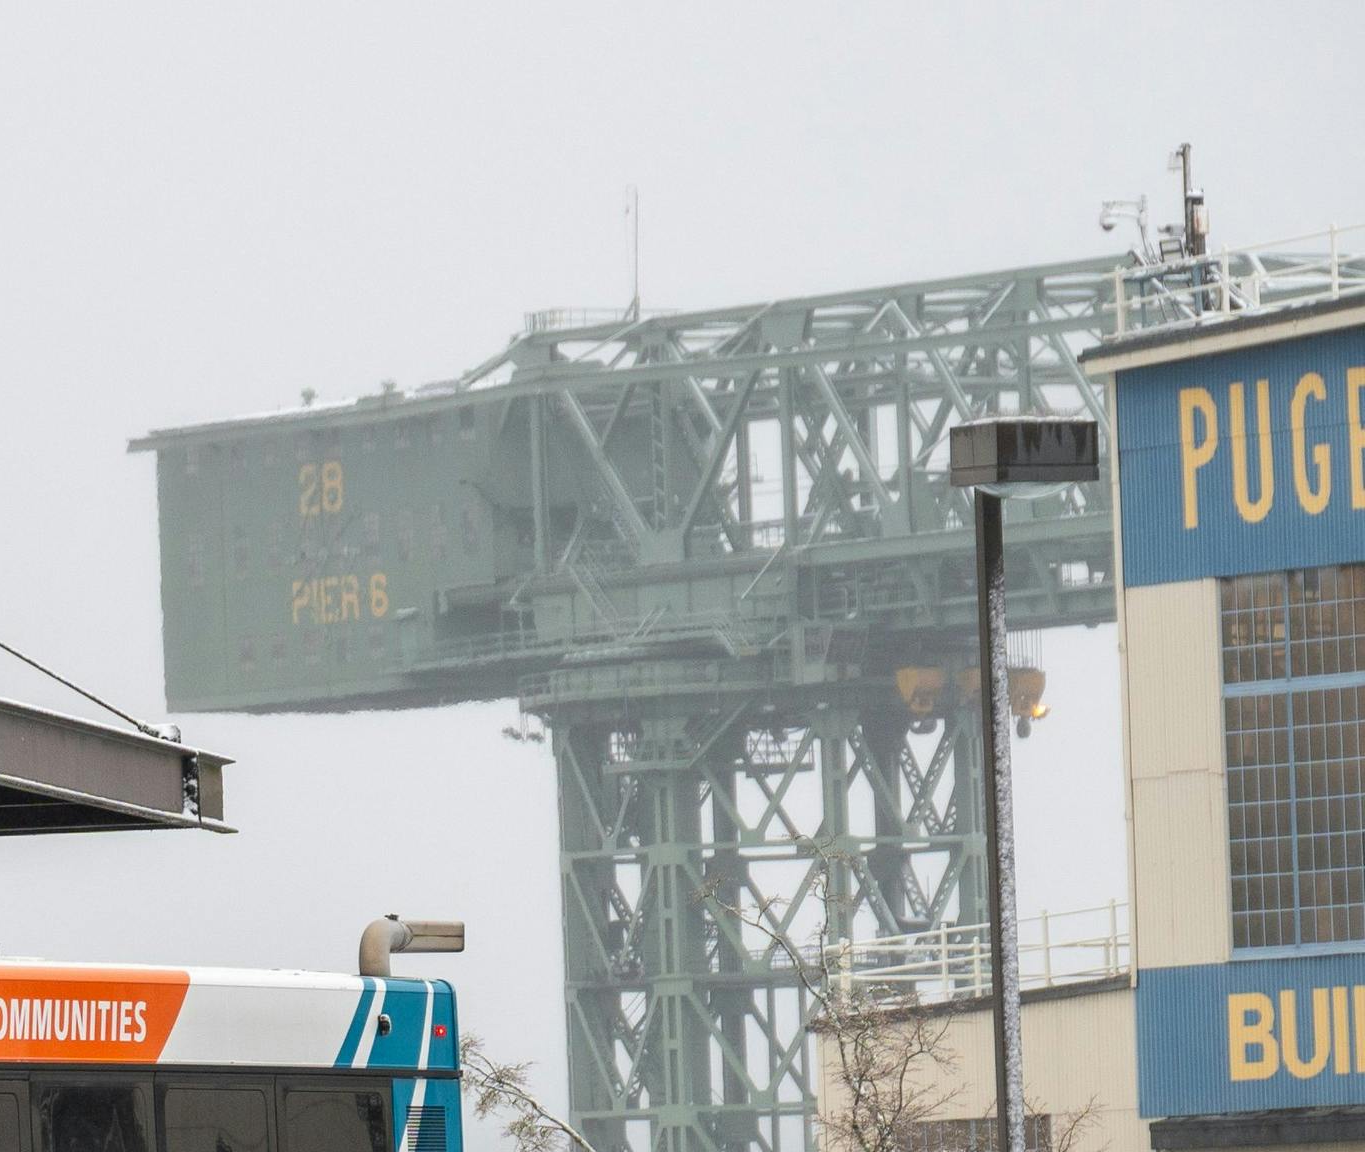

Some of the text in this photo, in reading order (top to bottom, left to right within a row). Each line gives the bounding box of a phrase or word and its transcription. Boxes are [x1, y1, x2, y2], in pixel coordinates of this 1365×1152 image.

[298, 460, 345, 517] 28
[292, 572, 389, 624] PIER 6
